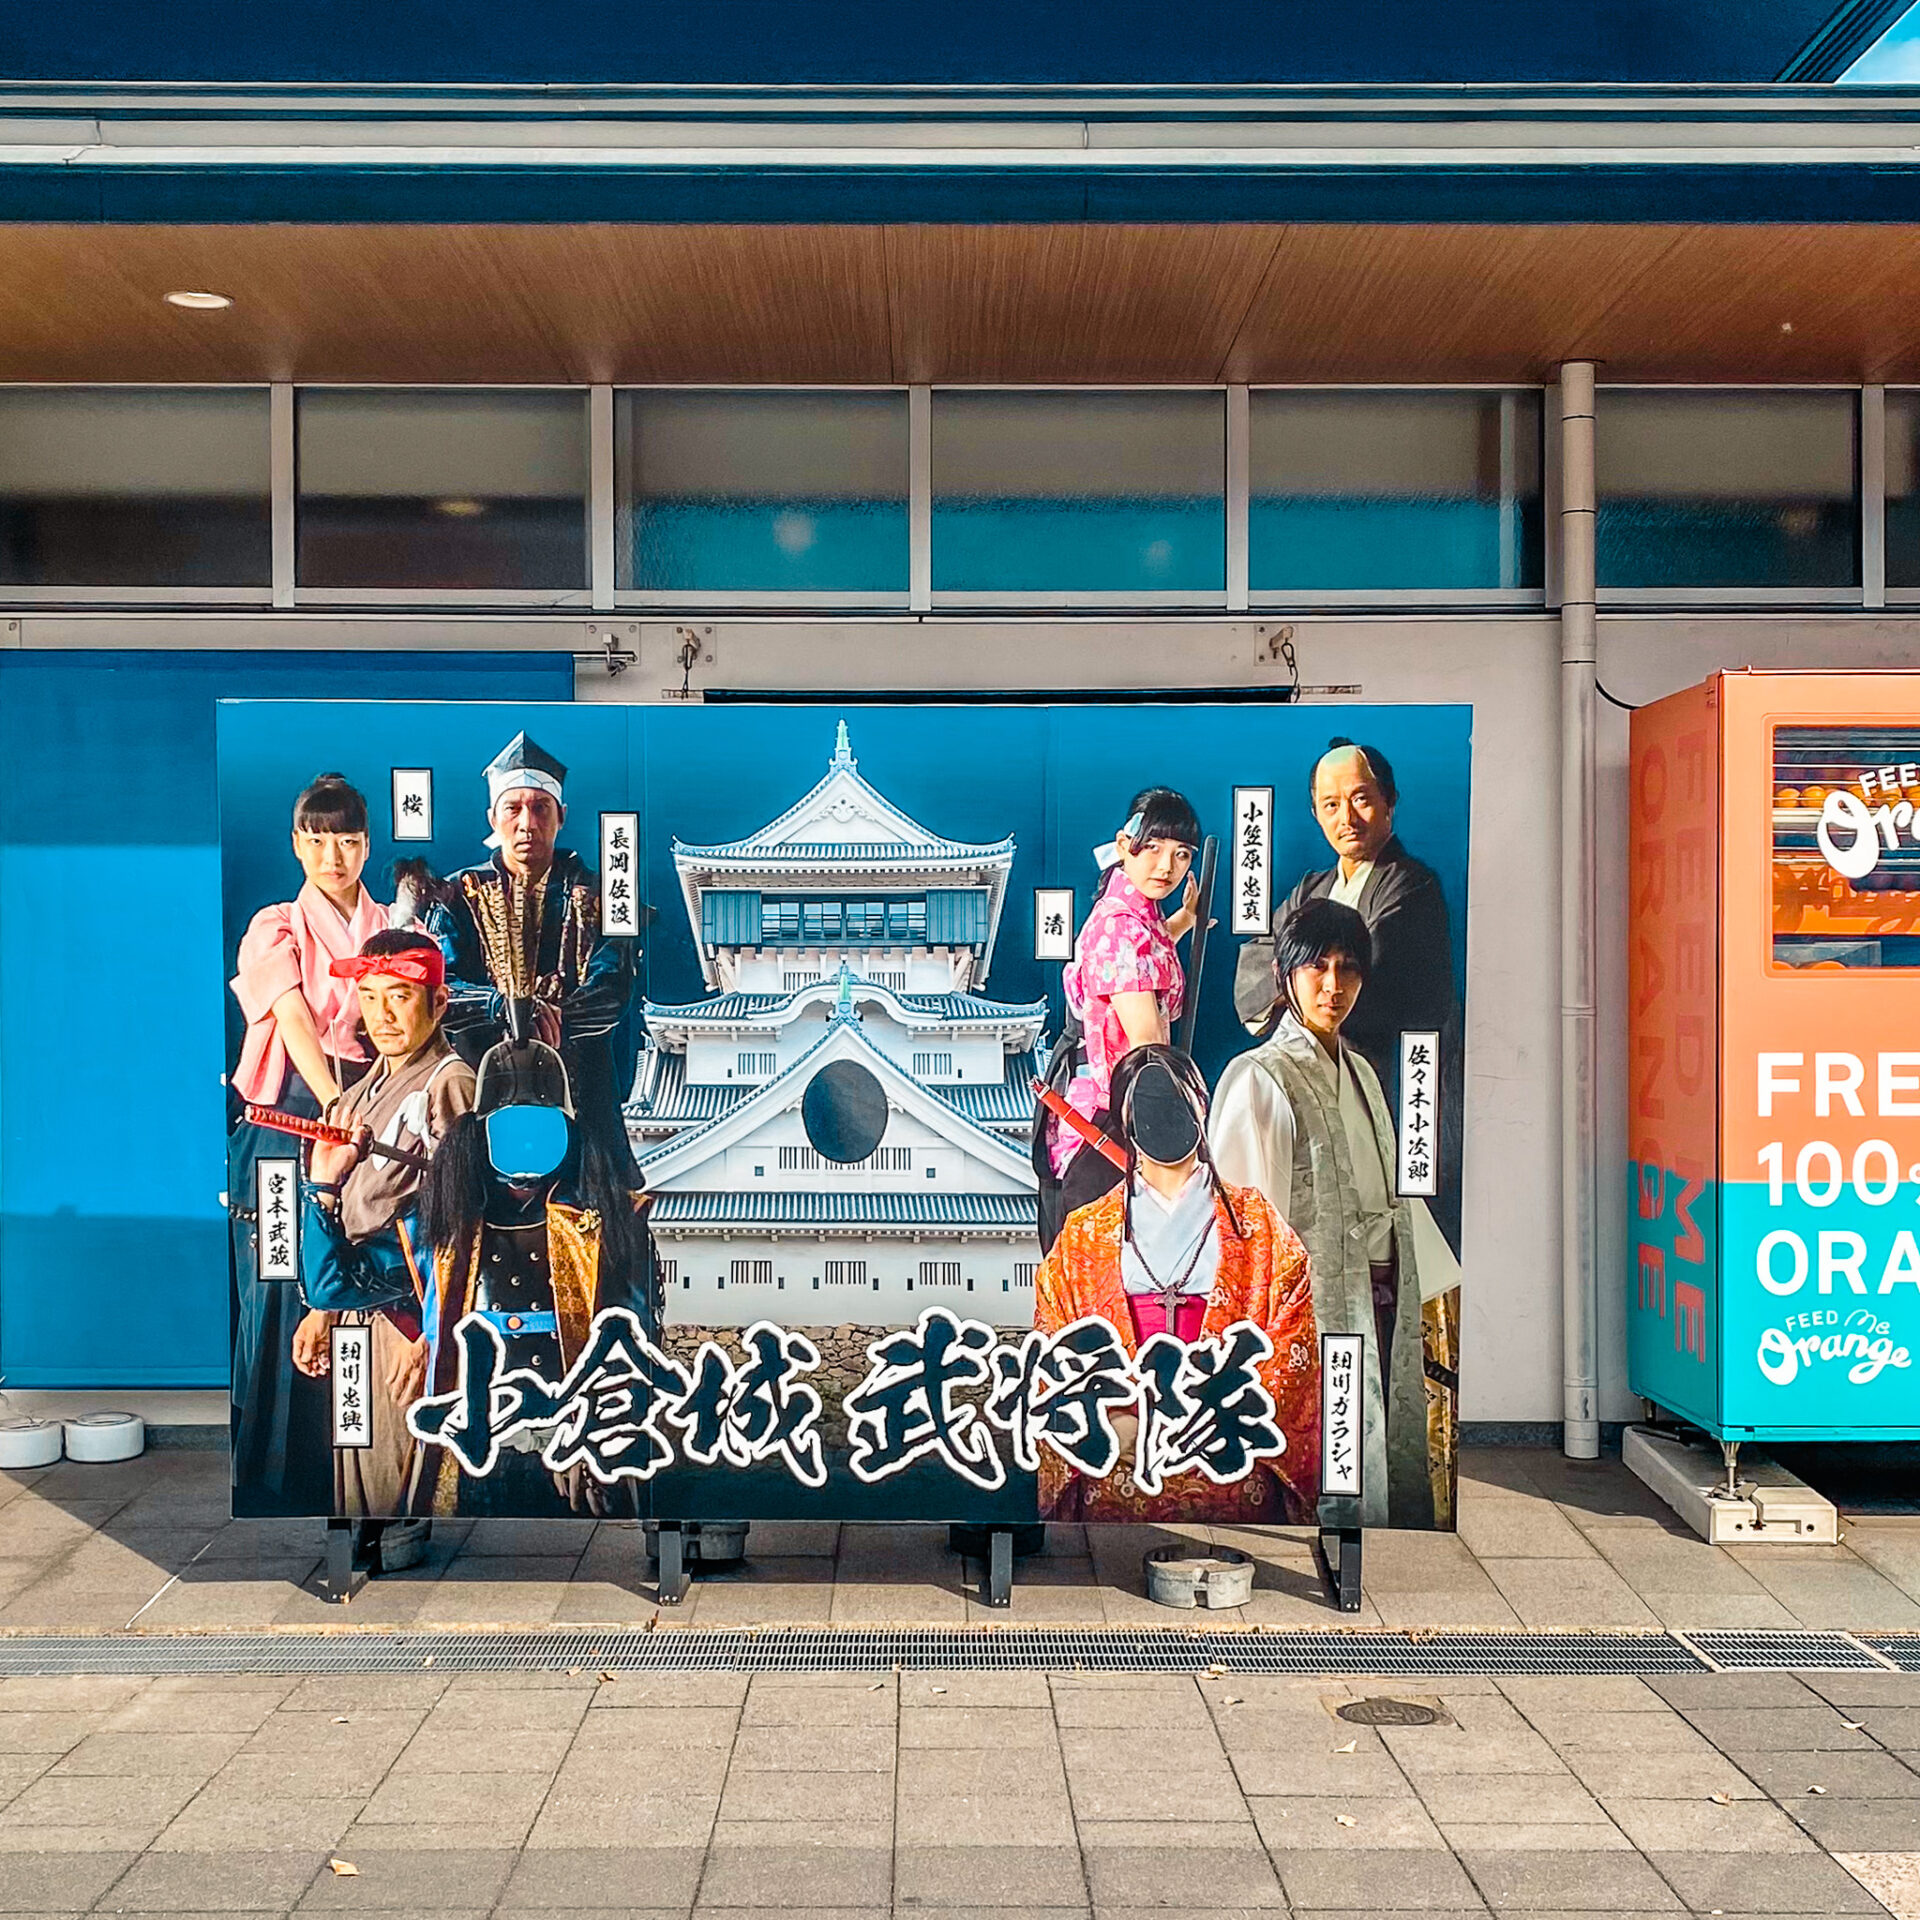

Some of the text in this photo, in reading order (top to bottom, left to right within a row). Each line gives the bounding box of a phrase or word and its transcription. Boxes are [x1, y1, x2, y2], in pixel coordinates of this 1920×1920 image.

[402, 793, 423, 817] 桜
[1858, 762, 1918, 798] FEE
[608, 827, 632, 925] 長岡佐渡
[1241, 801, 1264, 921] 小笠原忠真
[1817, 789, 1920, 879] Or
[1044, 913, 1065, 936] 清
[1638, 743, 1668, 1321] ORANGE
[1406, 1044, 1431, 1182] 佐々木小次郎
[1757, 1051, 1920, 1117] FRE
[266, 1173, 290, 1267] 宮本武蔵
[1674, 1156, 1706, 1365] ME
[1756, 1229, 1920, 1297] ORA
[1757, 1327, 1913, 1386] Orange
[1785, 1308, 1891, 1335] FEED Me
[407, 1306, 1287, 1496] 小倉城武将隊
[1331, 1350, 1353, 1480] 細川ガラシャ
